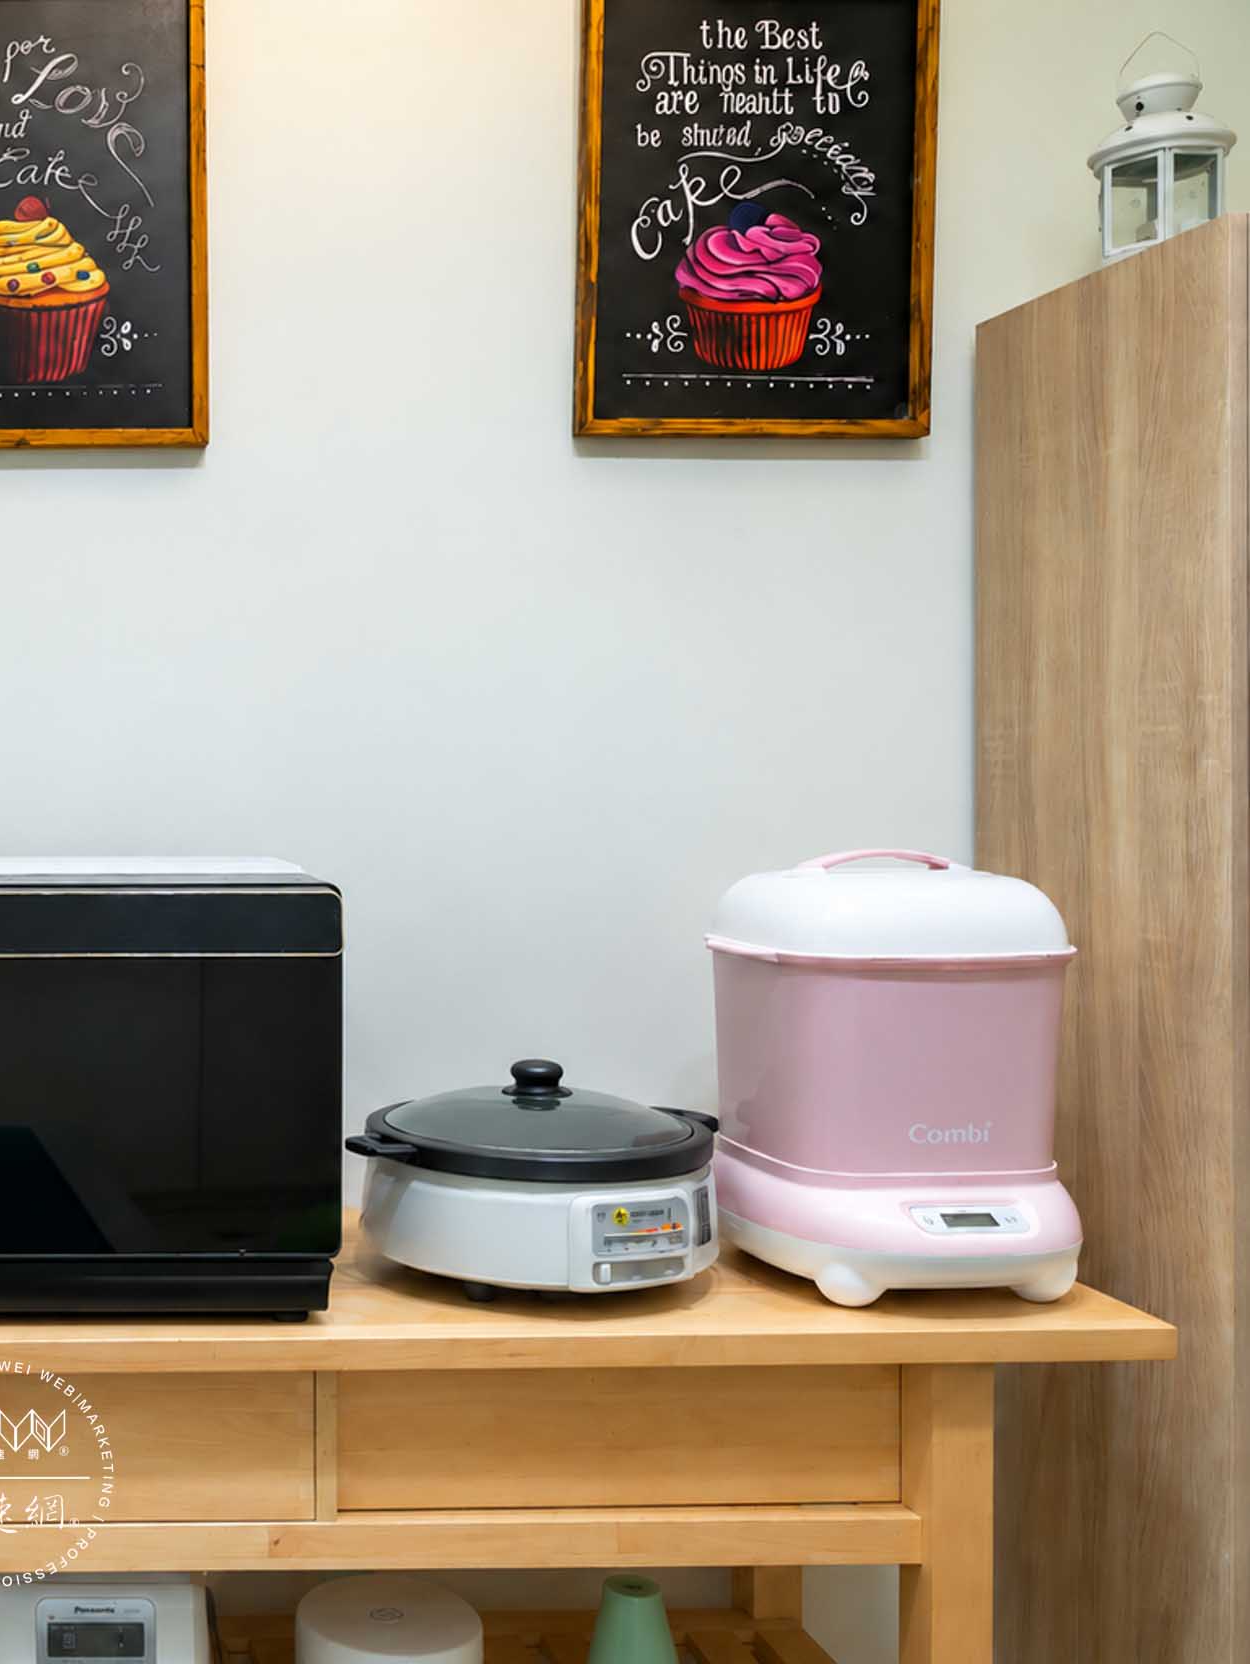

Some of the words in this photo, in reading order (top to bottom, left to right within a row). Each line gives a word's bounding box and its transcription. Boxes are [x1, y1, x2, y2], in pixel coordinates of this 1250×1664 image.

[700, 19, 749, 49] the
[754, 19, 823, 49] Best
[636, 51, 746, 92] Things
[754, 58, 778, 85] in
[786, 54, 870, 108] Life
[655, 89, 700, 115] are
[636, 123, 662, 147] be
[908, 1120, 993, 1144] Combi
